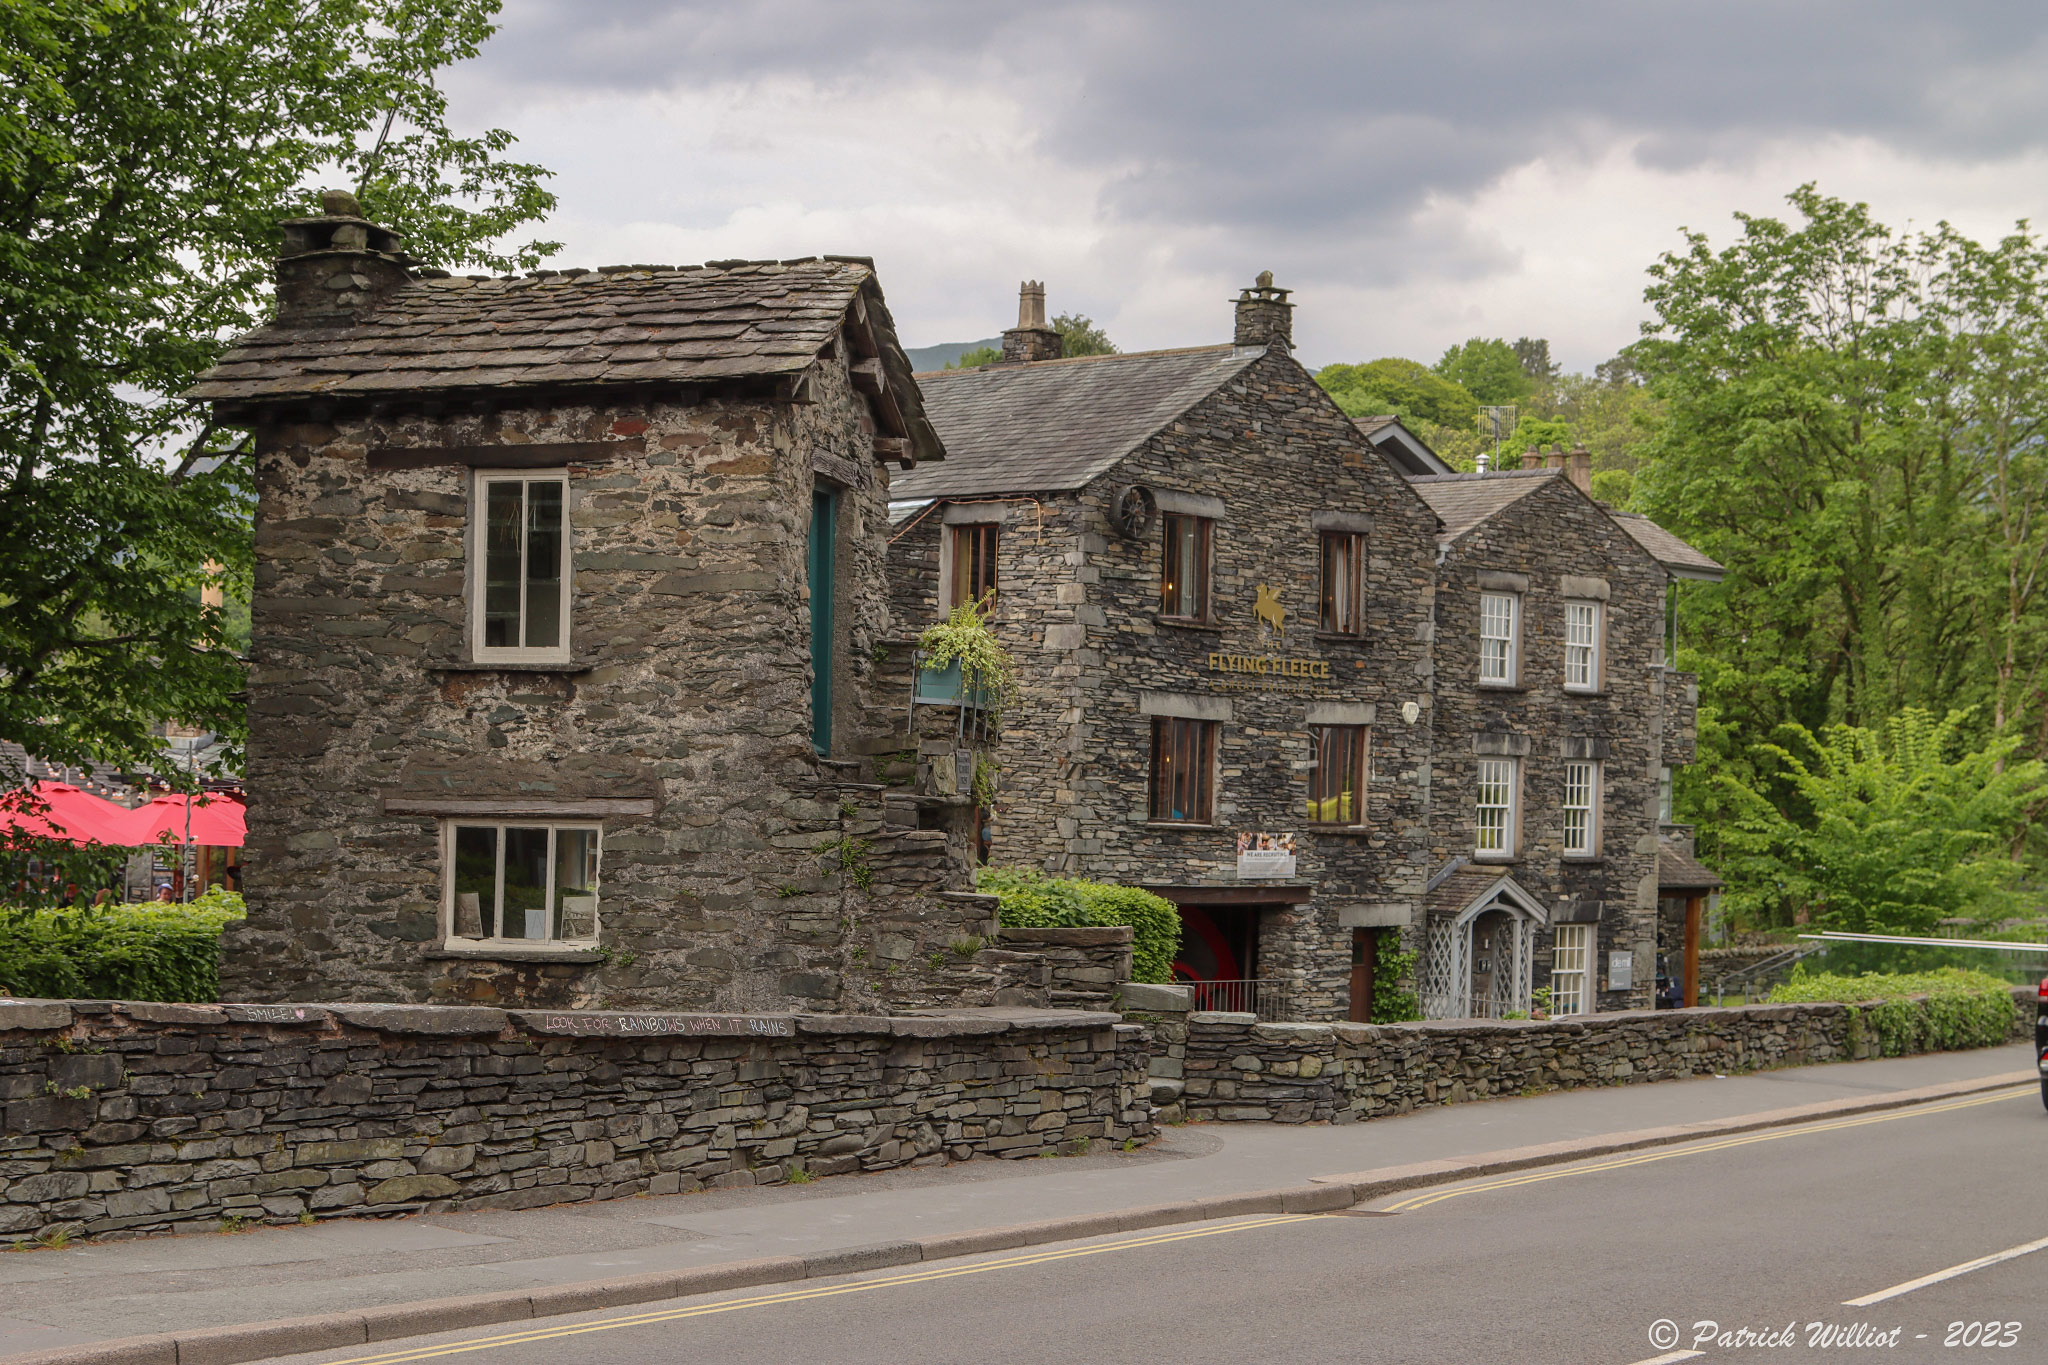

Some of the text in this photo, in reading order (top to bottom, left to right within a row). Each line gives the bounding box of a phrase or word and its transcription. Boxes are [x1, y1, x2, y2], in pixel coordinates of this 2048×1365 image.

[1261, 640, 1281, 649] THE
[1208, 652, 1329, 679] FLYING FLEECE
[1221, 680, 1255, 690] GREAT
[1261, 682, 1304, 694] BRITISH
[1310, 685, 1329, 695] PUB
[247, 1007, 295, 1021] SMILE!
[546, 1015, 788, 1036] LOOK FOR RAINBOWS WHEN IT RAINS
